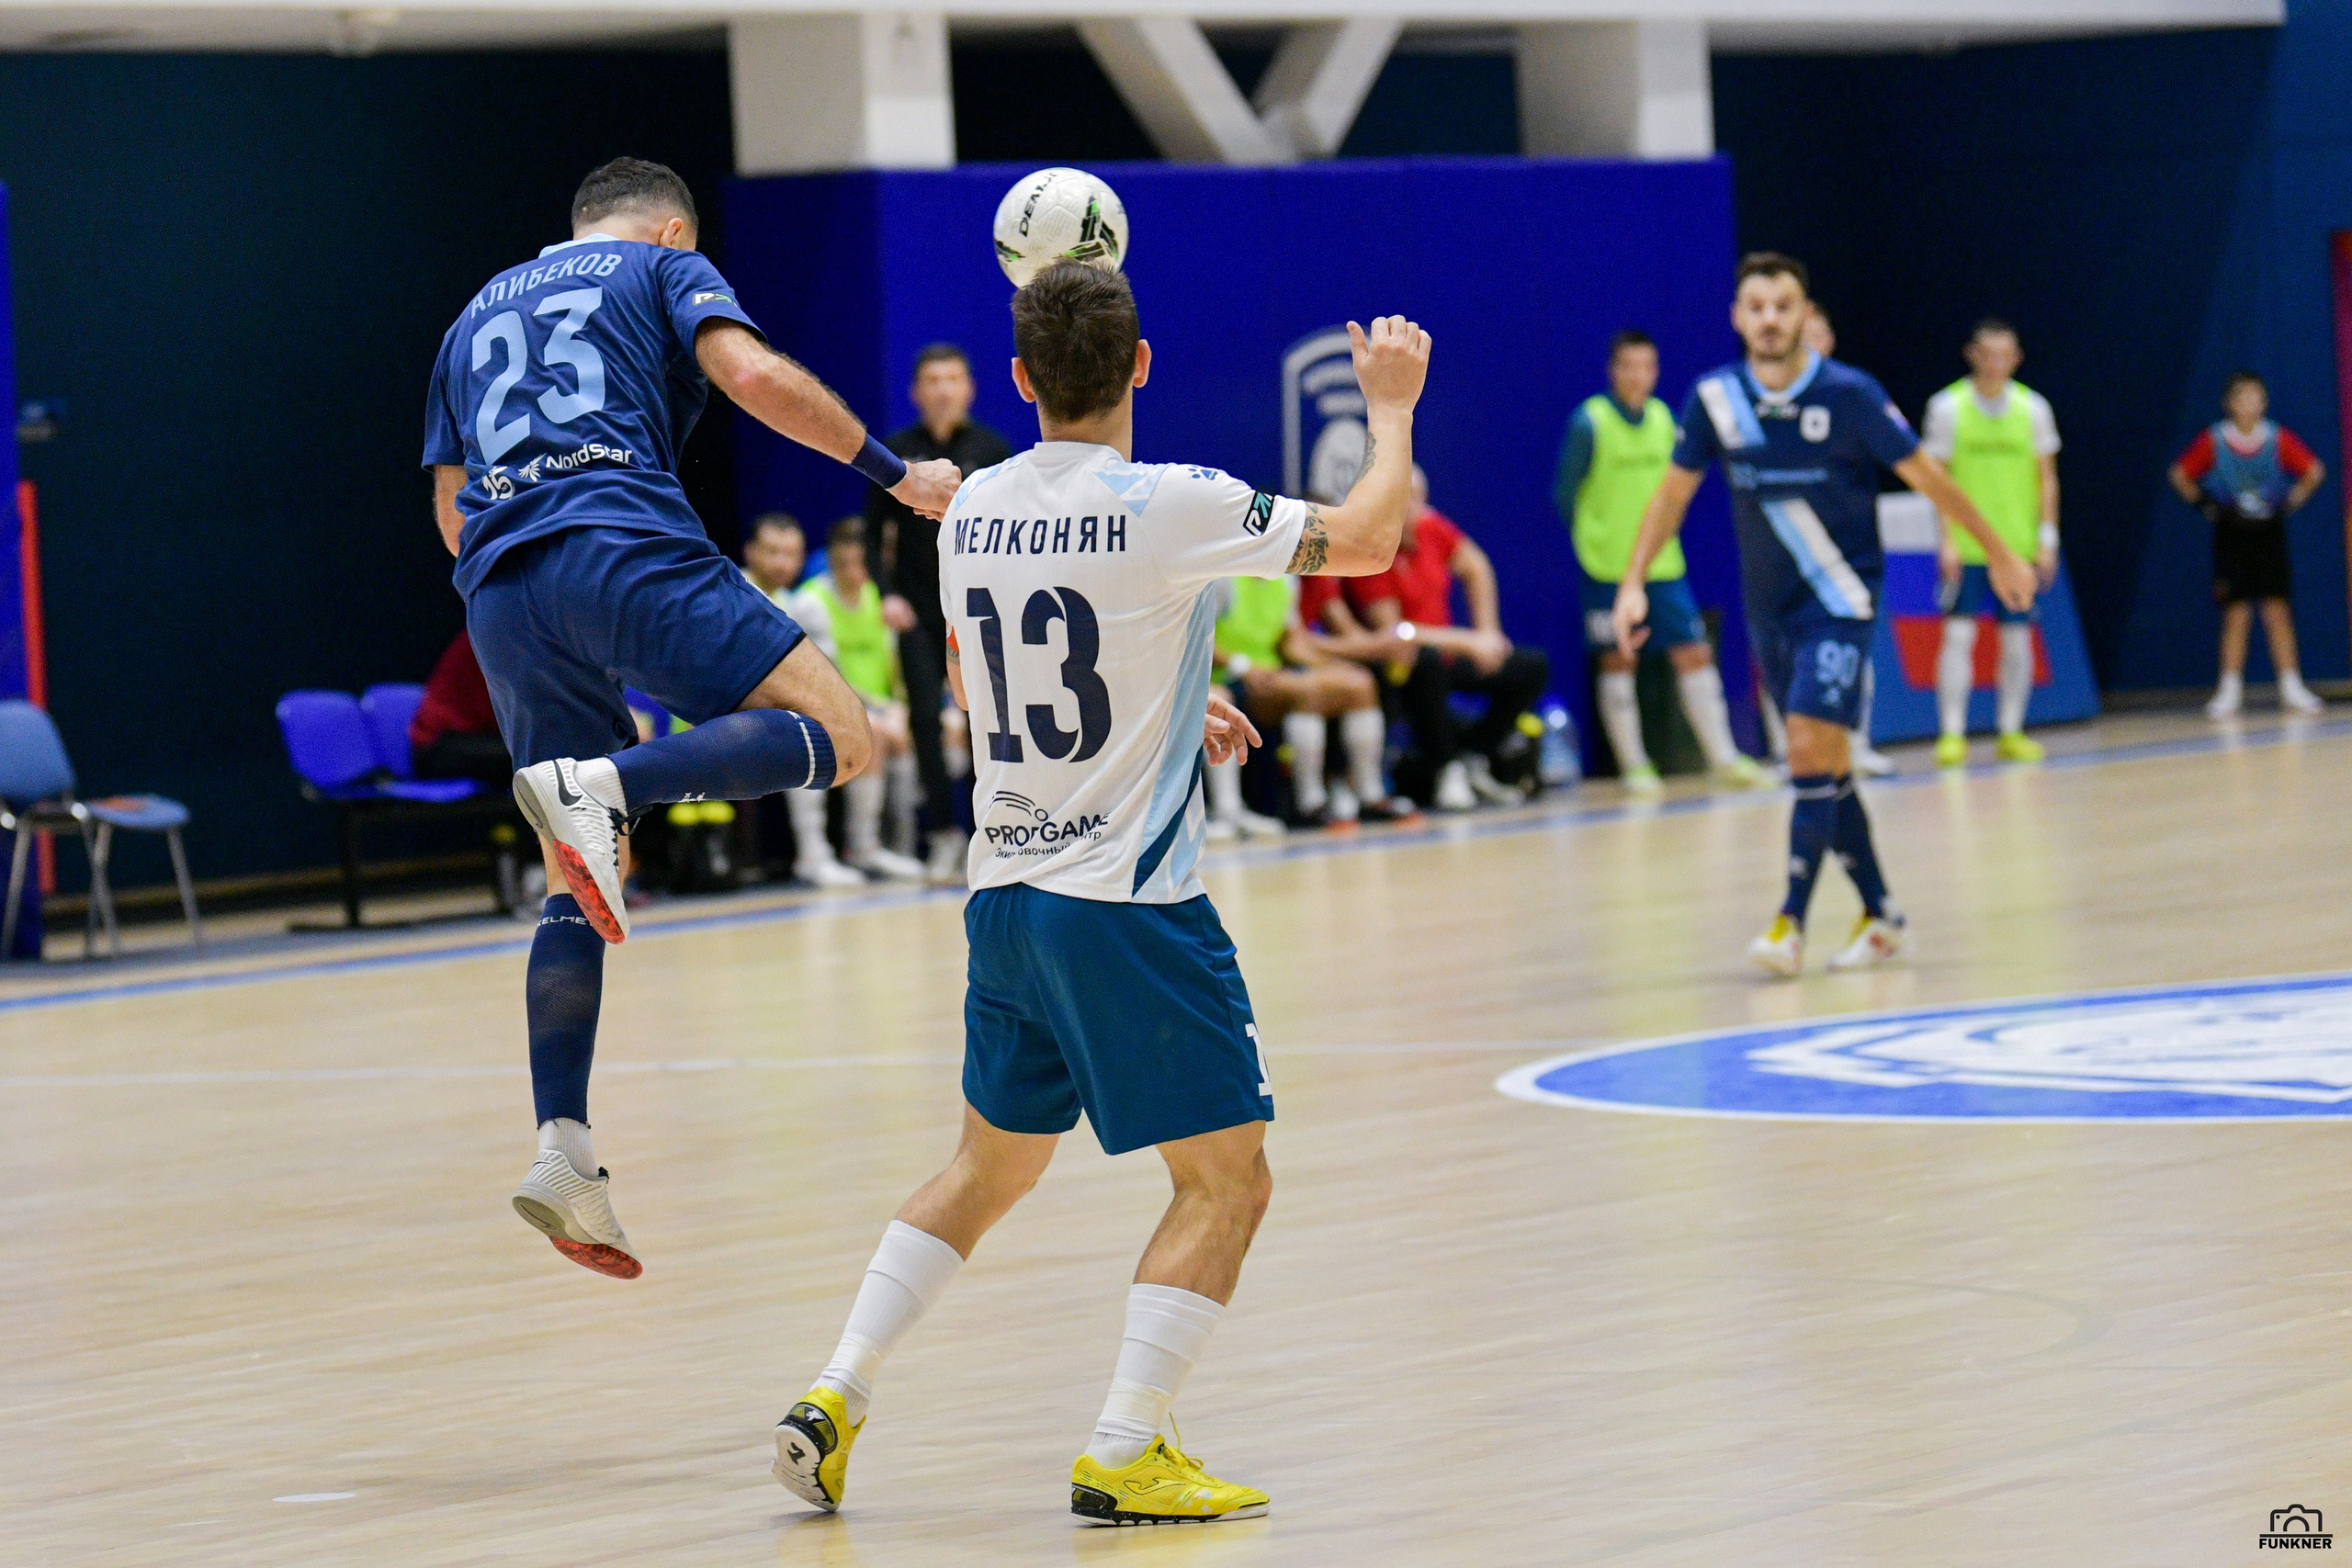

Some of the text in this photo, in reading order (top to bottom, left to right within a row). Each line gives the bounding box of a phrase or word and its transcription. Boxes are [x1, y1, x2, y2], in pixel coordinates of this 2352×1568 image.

[470, 253, 623, 320] АЛИБЕКОВ
[471, 286, 606, 466] 23
[546, 443, 633, 469] NordStar
[954, 514, 1126, 556] МЕЛКОНЯН
[967, 586, 1112, 763] 13
